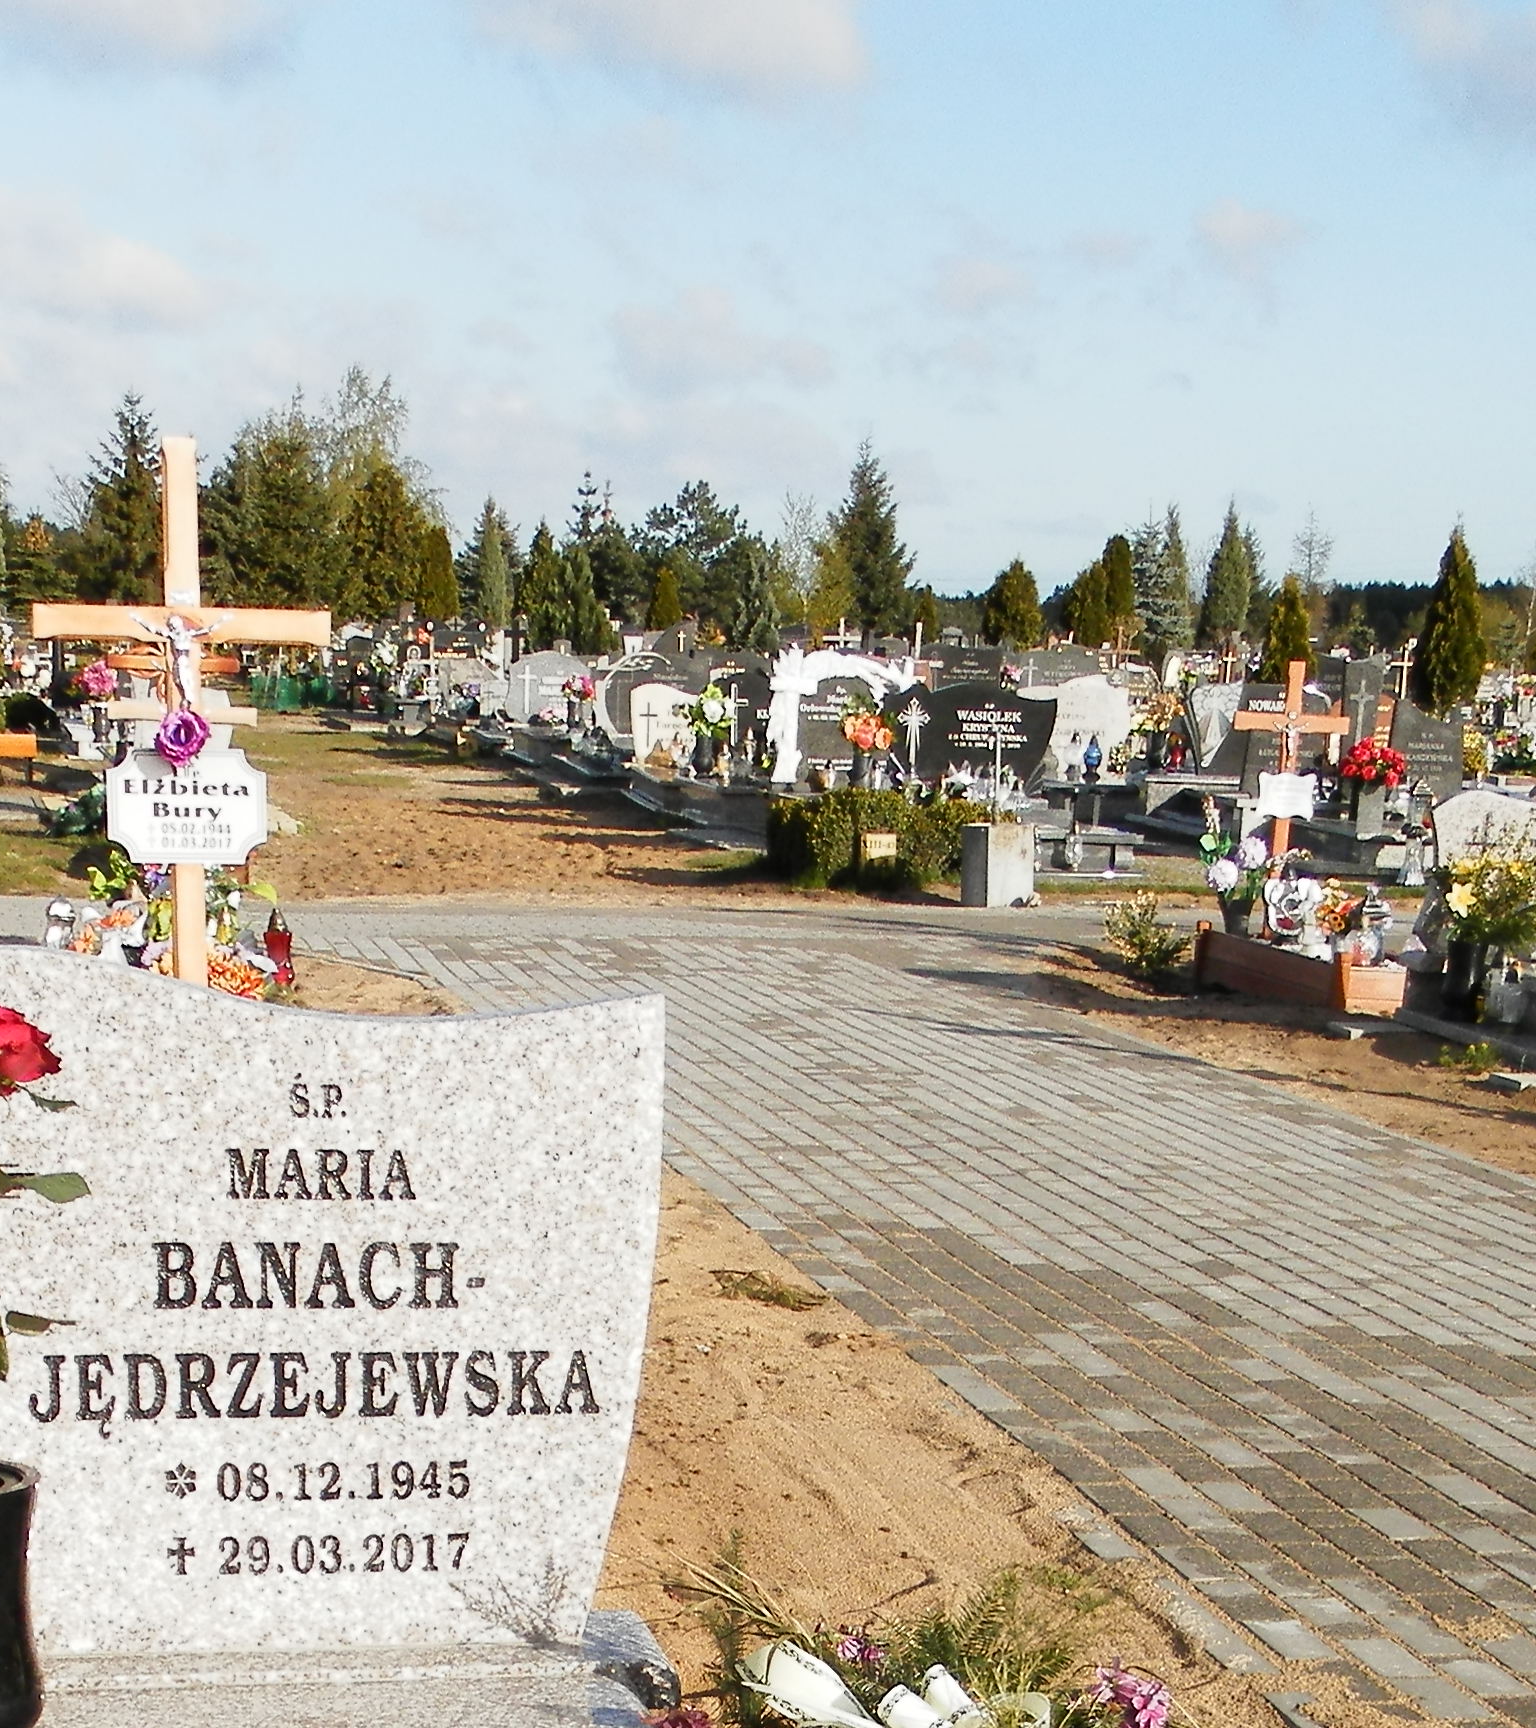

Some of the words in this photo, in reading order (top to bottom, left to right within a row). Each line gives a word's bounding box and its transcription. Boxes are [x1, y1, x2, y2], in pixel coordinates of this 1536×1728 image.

[124, 779, 249, 796] Elżbieta
[153, 802, 222, 821] Bury
[161, 823, 232, 835] 05.02.1944
[161, 837, 232, 849] 01.03.2017
[289, 1074, 347, 1118] Ś.P.
[226, 1148, 417, 1201] MARIA
[152, 1241, 485, 1310] BANACH-
[28, 1349, 601, 1439] JĘDRZEJEWSKA
[216, 1460, 472, 1501] 08.12.1945
[218, 1531, 470, 1575] 29.03.2017
